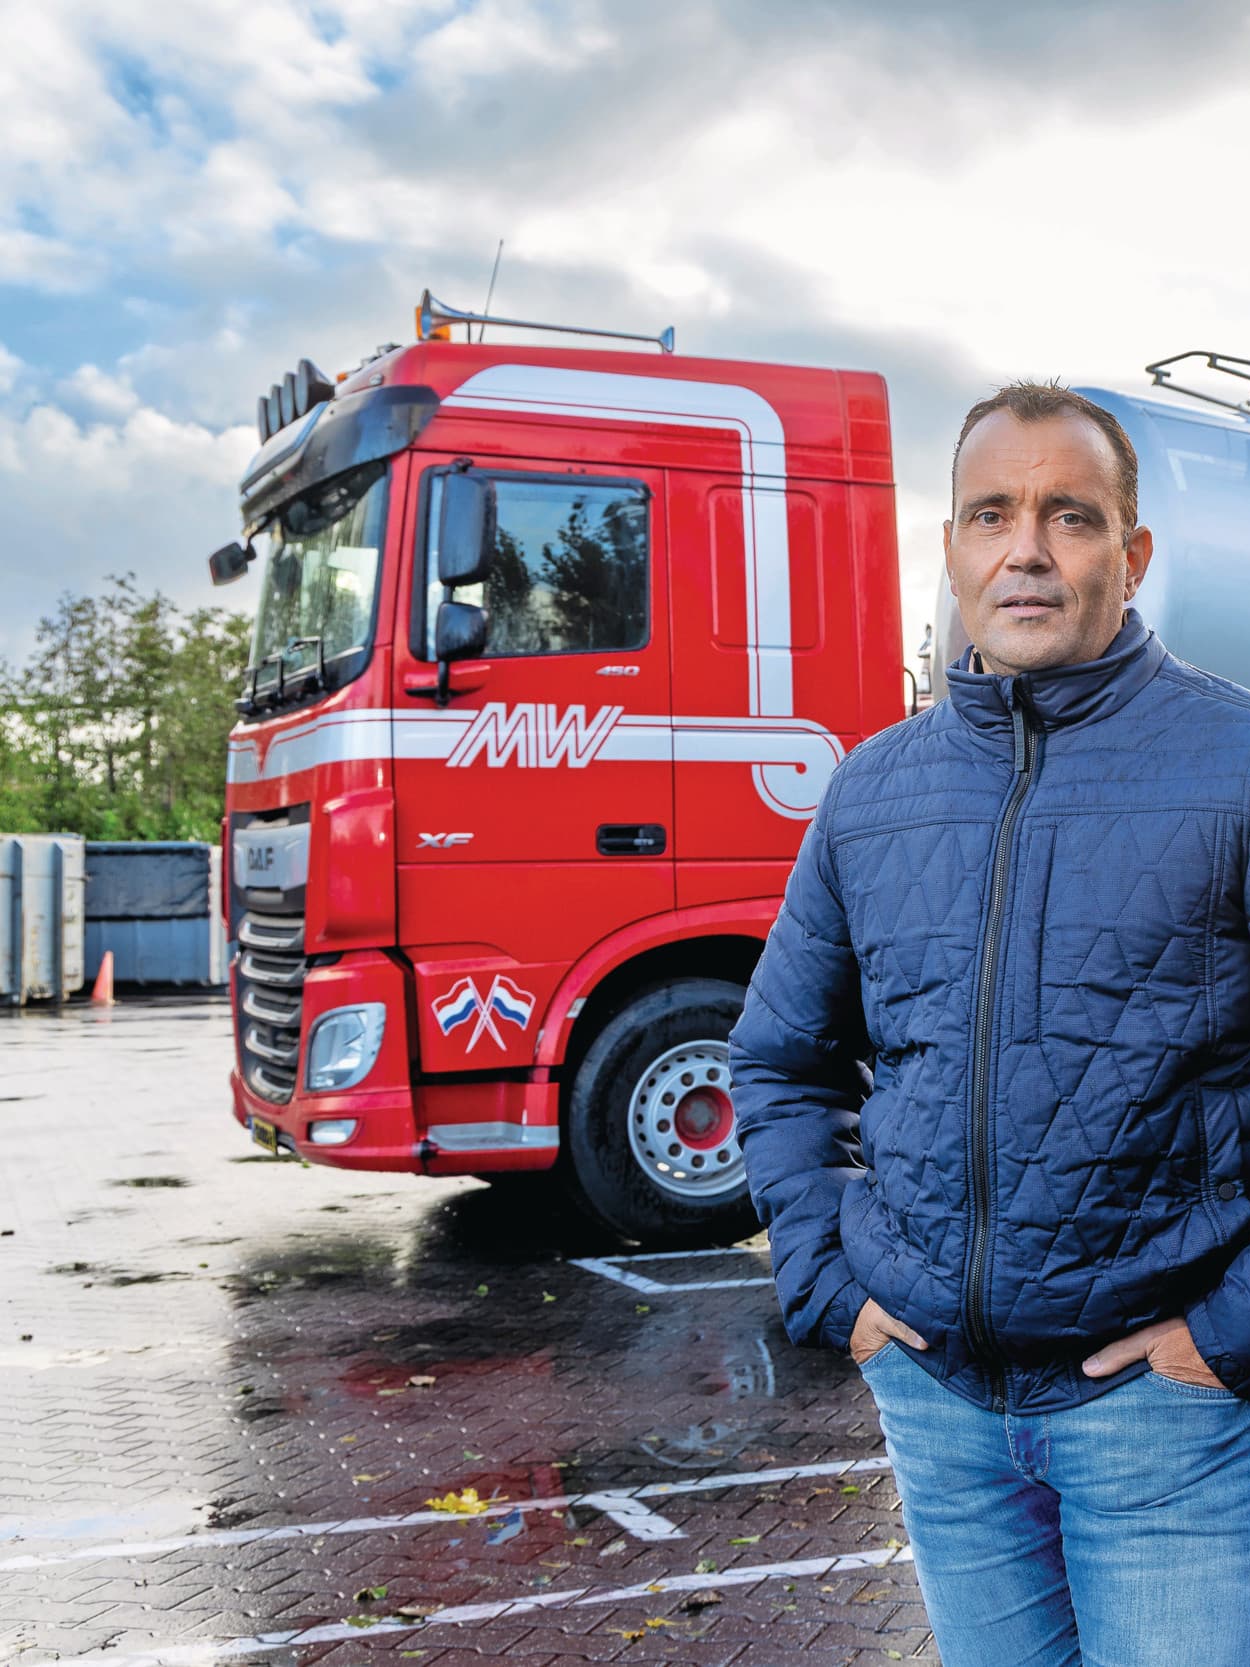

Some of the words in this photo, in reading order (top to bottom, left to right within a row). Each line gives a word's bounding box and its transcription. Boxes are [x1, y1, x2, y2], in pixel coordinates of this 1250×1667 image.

[595, 665, 640, 677] 450
[445, 701, 625, 769] MW
[415, 832, 475, 849] XF
[247, 847, 275, 872] DAF
